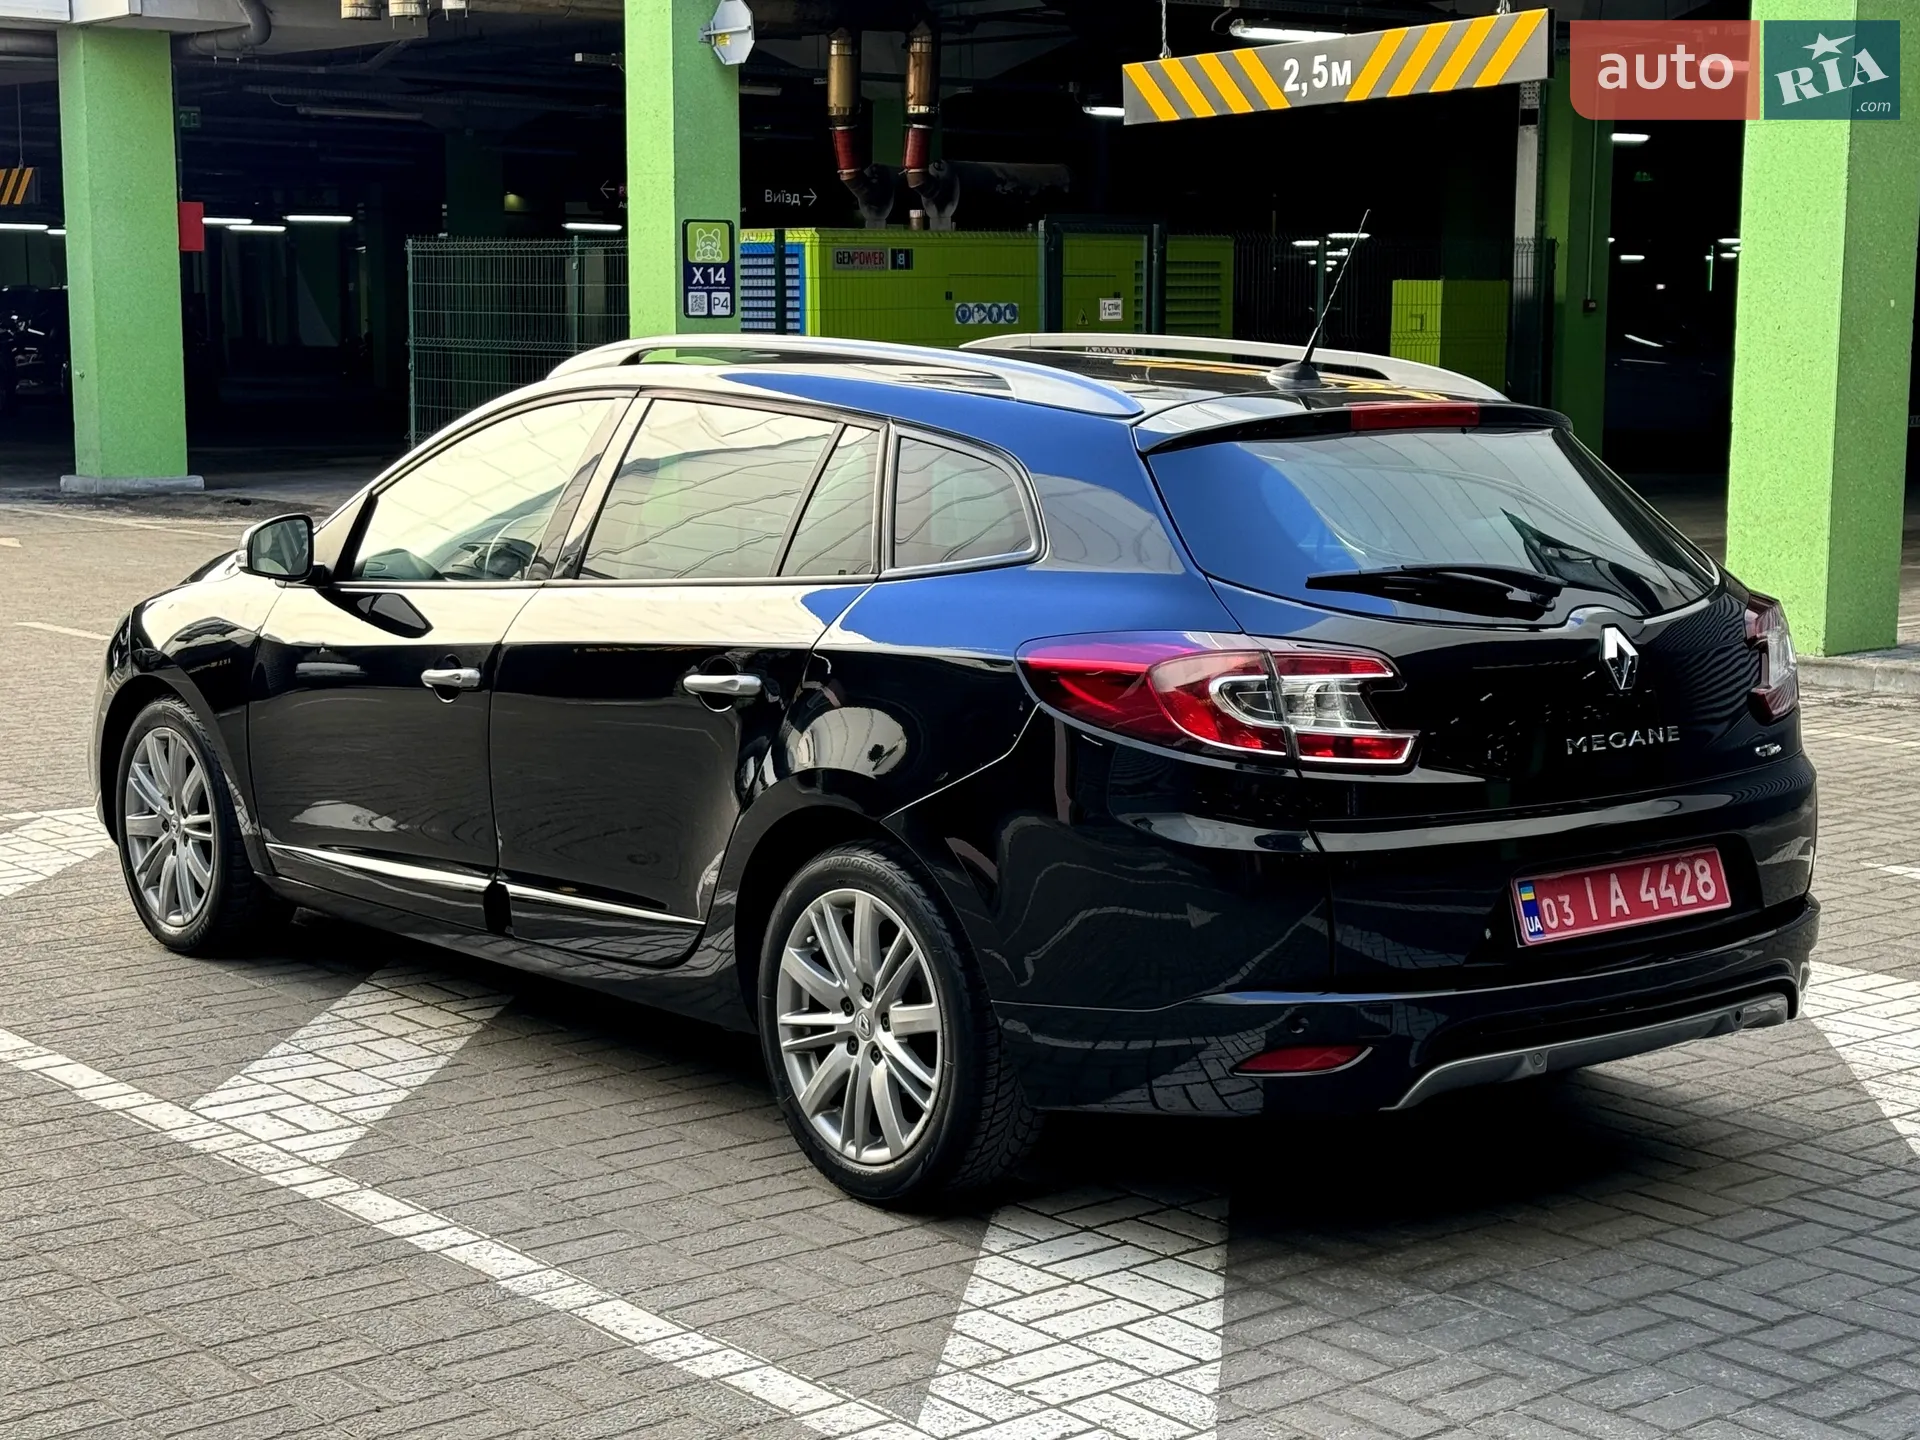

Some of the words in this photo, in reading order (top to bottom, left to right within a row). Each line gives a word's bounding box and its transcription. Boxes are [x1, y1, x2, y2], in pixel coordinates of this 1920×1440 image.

[764, 189, 801, 206] Виїзд
[836, 251, 885, 265] GENPOWER
[707, 266, 727, 285] 14
[712, 296, 729, 311] P4
[1566, 725, 1680, 755] MEGANE
[823, 857, 903, 892] BRIDGESTONE
[1541, 894, 1575, 929] 03
[1639, 858, 1717, 911] 4428
[1525, 916, 1543, 933] UA
